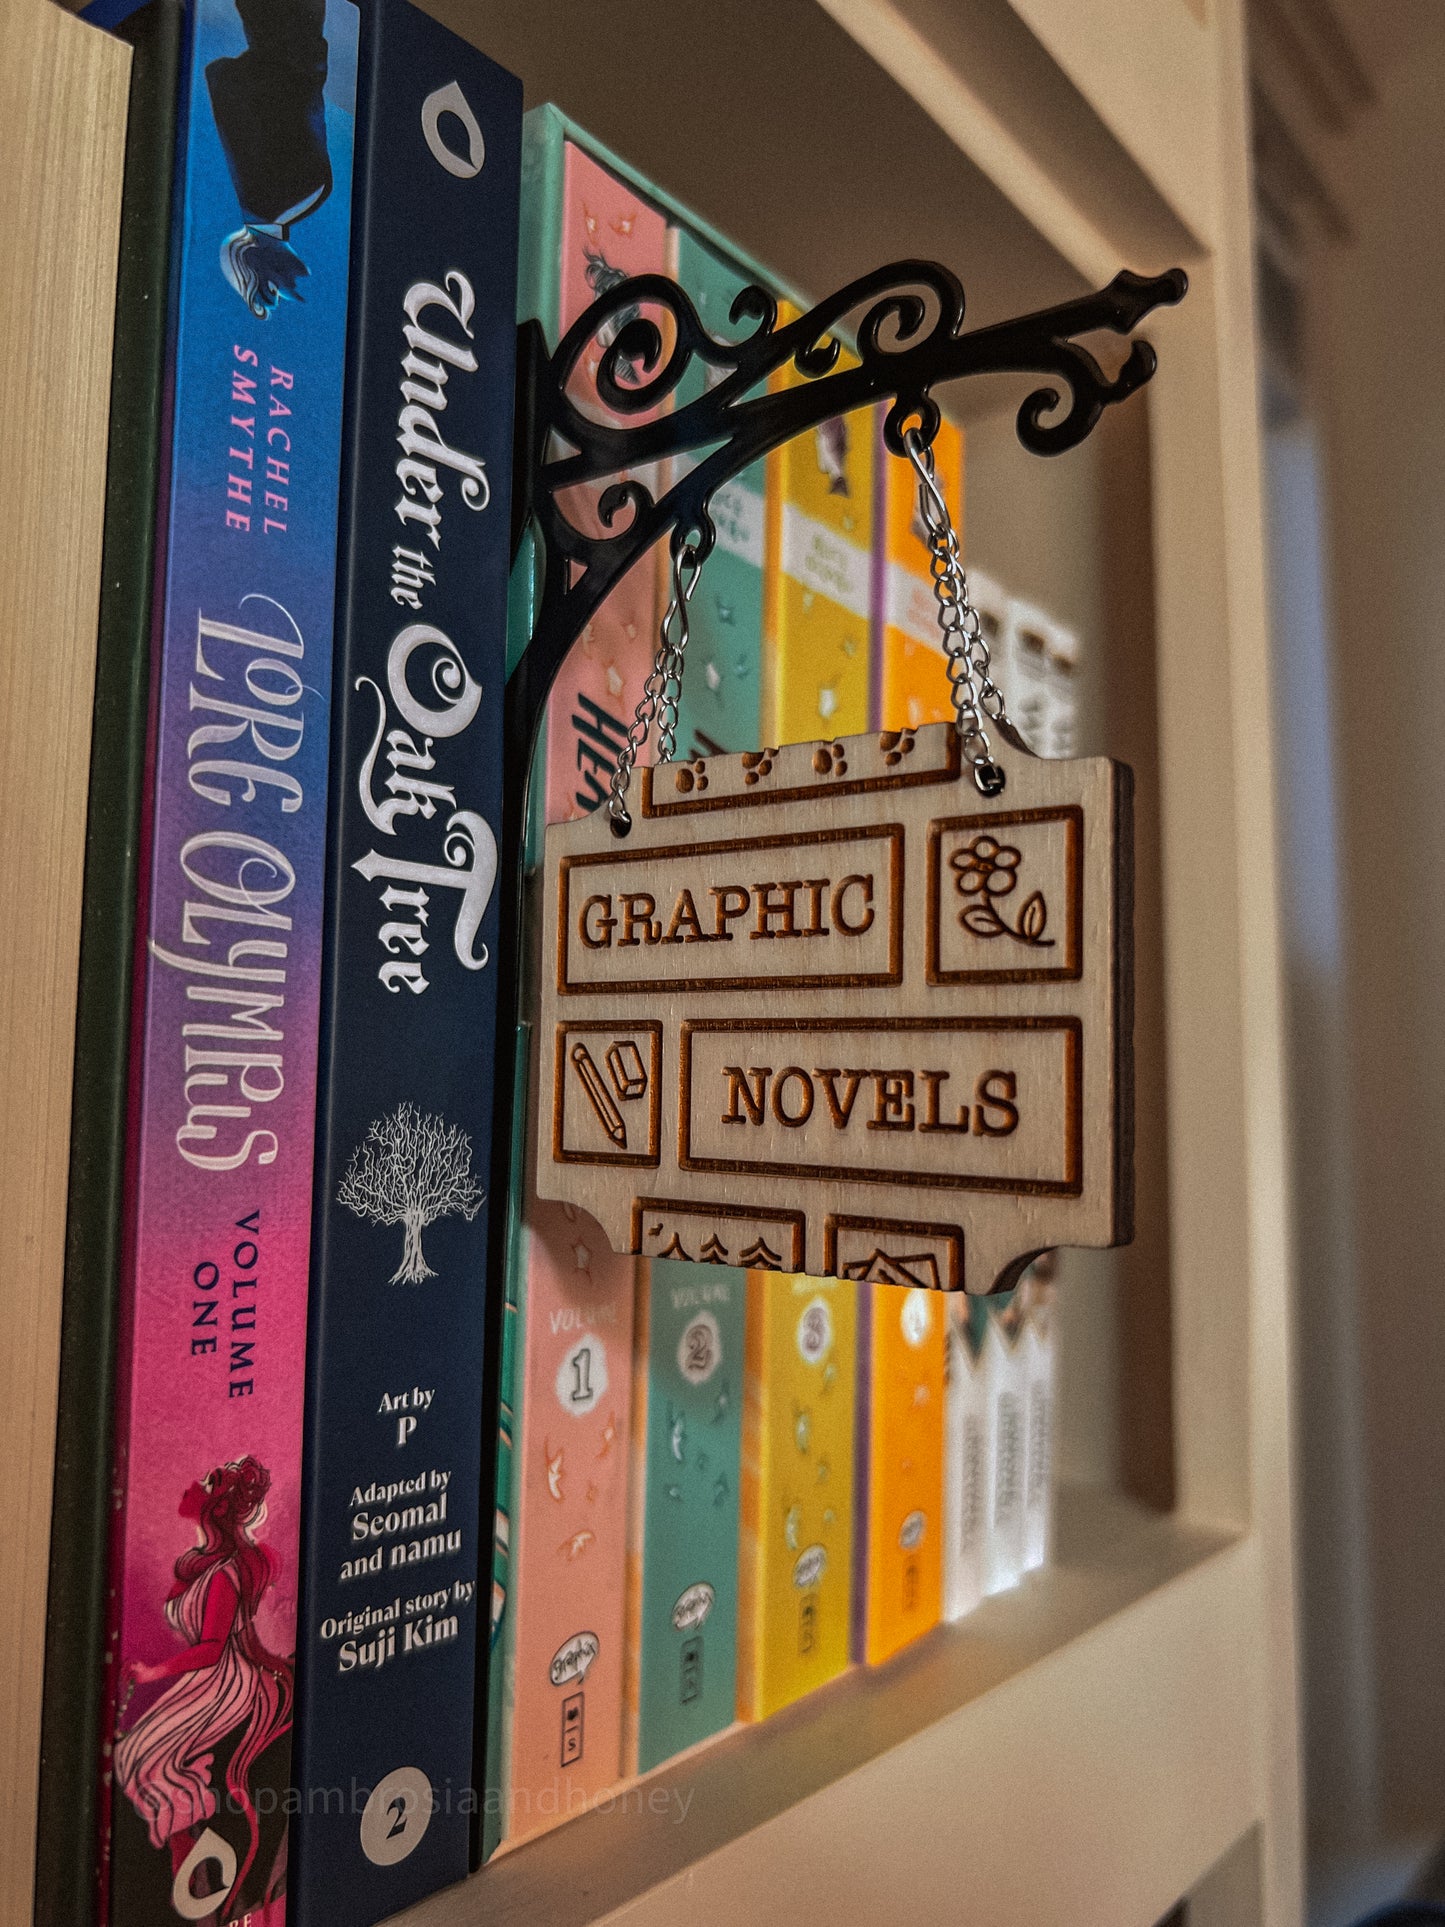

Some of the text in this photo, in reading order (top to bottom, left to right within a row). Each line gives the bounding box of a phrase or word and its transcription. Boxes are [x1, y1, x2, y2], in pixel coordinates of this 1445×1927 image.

[225, 344, 258, 532] SMYTHE
[264, 365, 294, 534] RACHEL
[390, 271, 490, 609] Under the
[186, 594, 325, 814] LORE
[351, 624, 498, 995] Oak Tree
[578, 873, 876, 949] GRAPHIC
[721, 1067, 1019, 1138] NOVELS
[191, 1261, 219, 1356] ONE
[229, 1209, 260, 1398] VOLUME
[377, 1386, 435, 1412] Art by
[573, 1348, 593, 1401] 1
[398, 1415, 417, 1447] P
[350, 1469, 451, 1506] Adapted by
[353, 1493, 447, 1541] Seomal
[340, 1529, 461, 1580] and namu
[321, 1579, 475, 1640] Original story by
[339, 1614, 459, 1672] Suji Kim
[386, 1797, 408, 1840] 2
